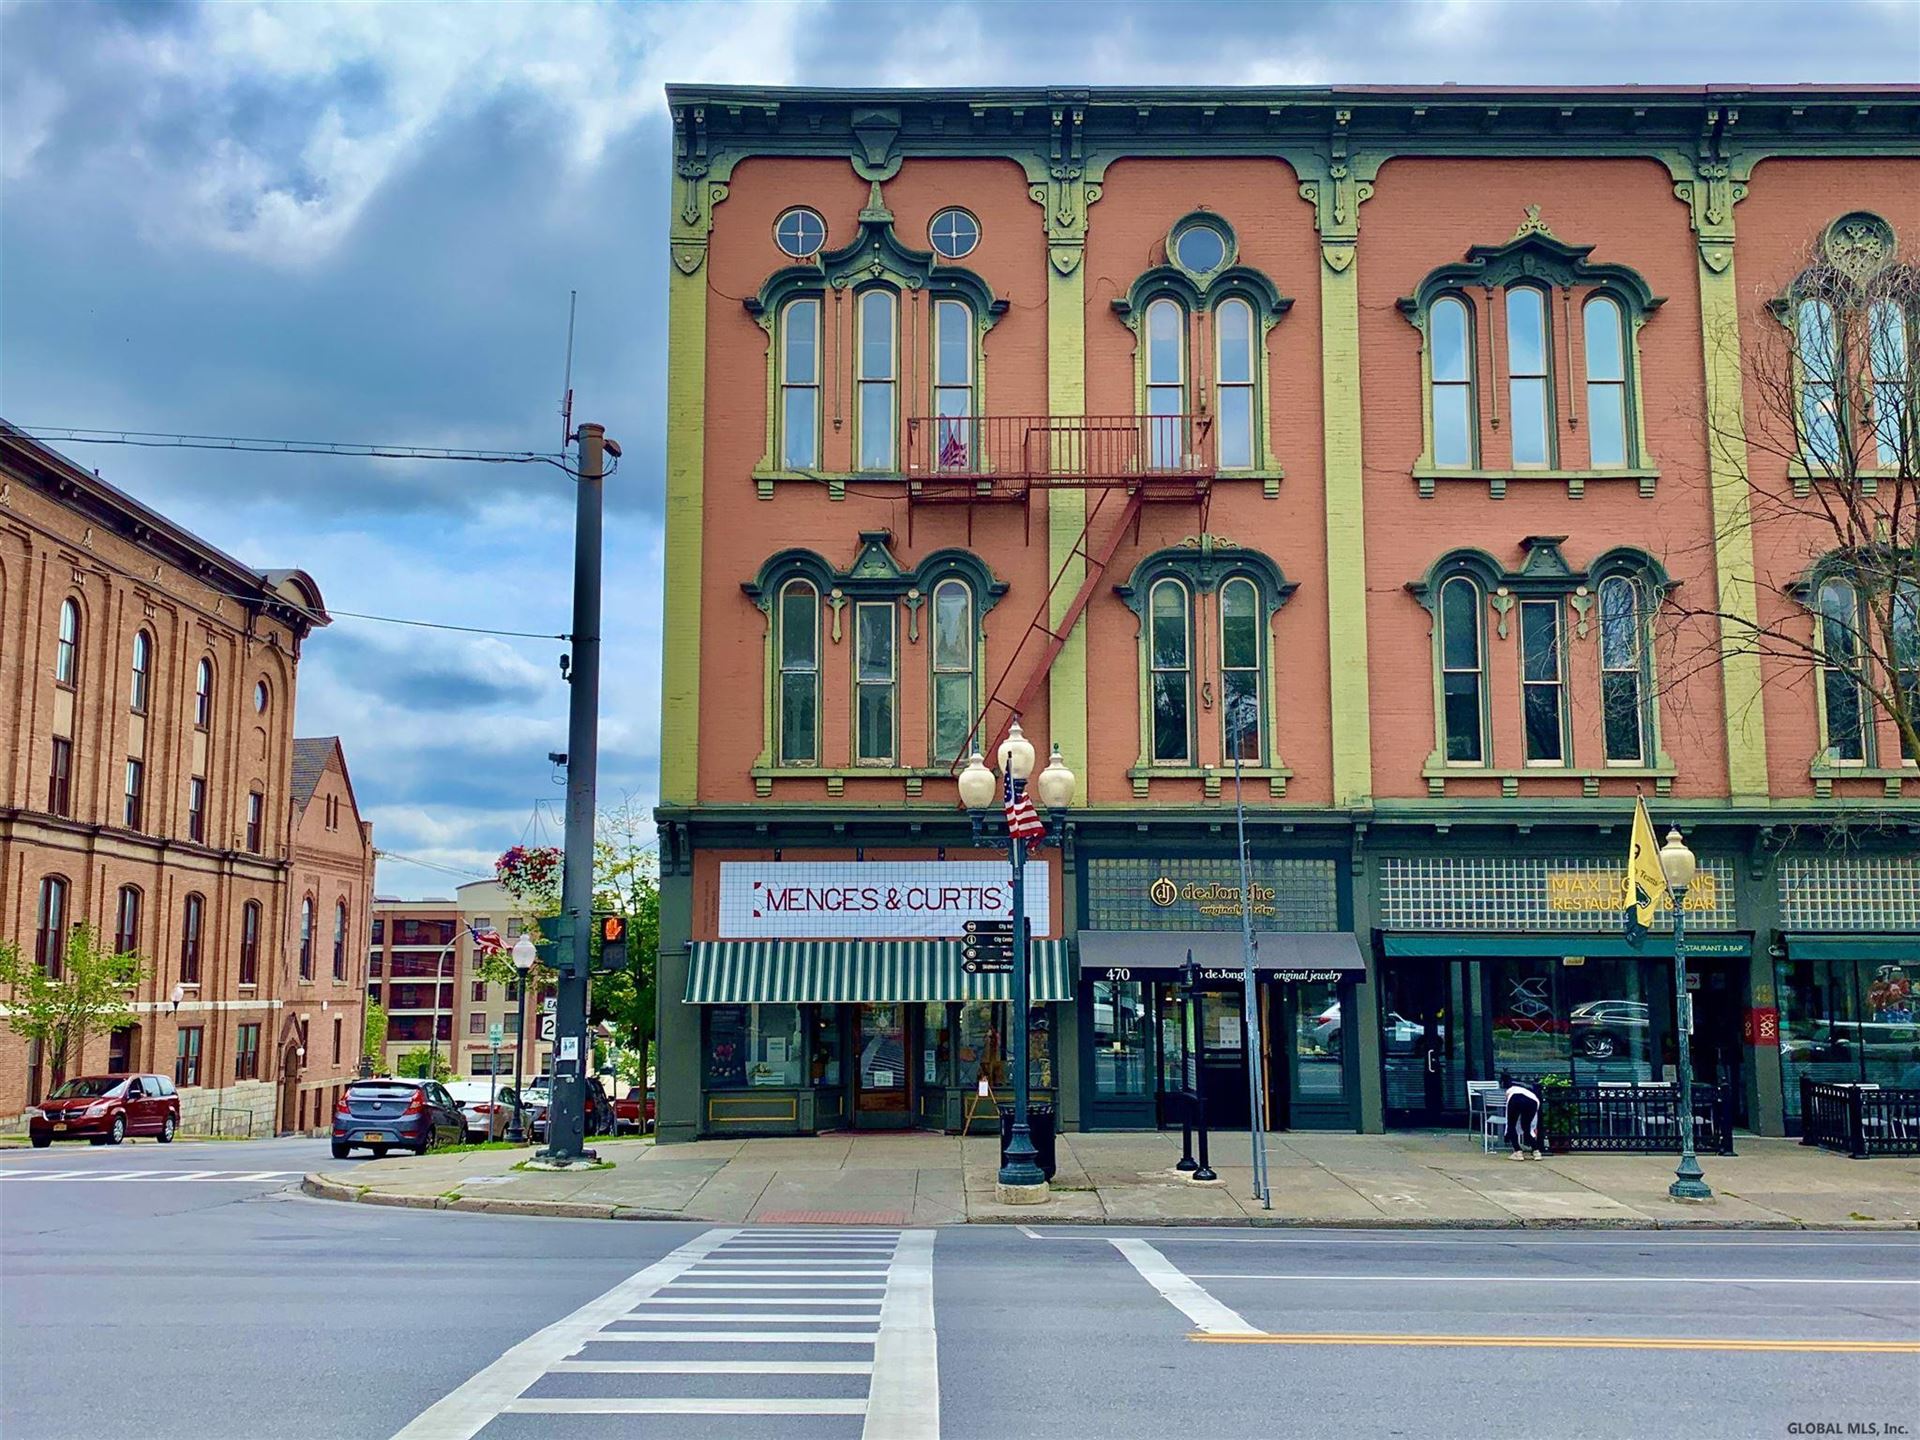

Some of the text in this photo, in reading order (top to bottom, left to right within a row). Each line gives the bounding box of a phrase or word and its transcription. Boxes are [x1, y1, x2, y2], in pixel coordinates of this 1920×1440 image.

[1551, 876, 1716, 893] MAX LON'S
[1181, 882, 1276, 902] deJonhe
[767, 887, 1002, 911] MENGES & CURTIS
[1664, 898, 1675, 910] &
[1684, 898, 1716, 910] BAR
[1200, 904, 1239, 917] original
[1685, 944, 1722, 952] STAURANT
[1106, 968, 1130, 981] 470
[1205, 968, 1255, 982] deJong
[1273, 970, 1342, 983] original jewelry
[547, 1000, 557, 1009] EA
